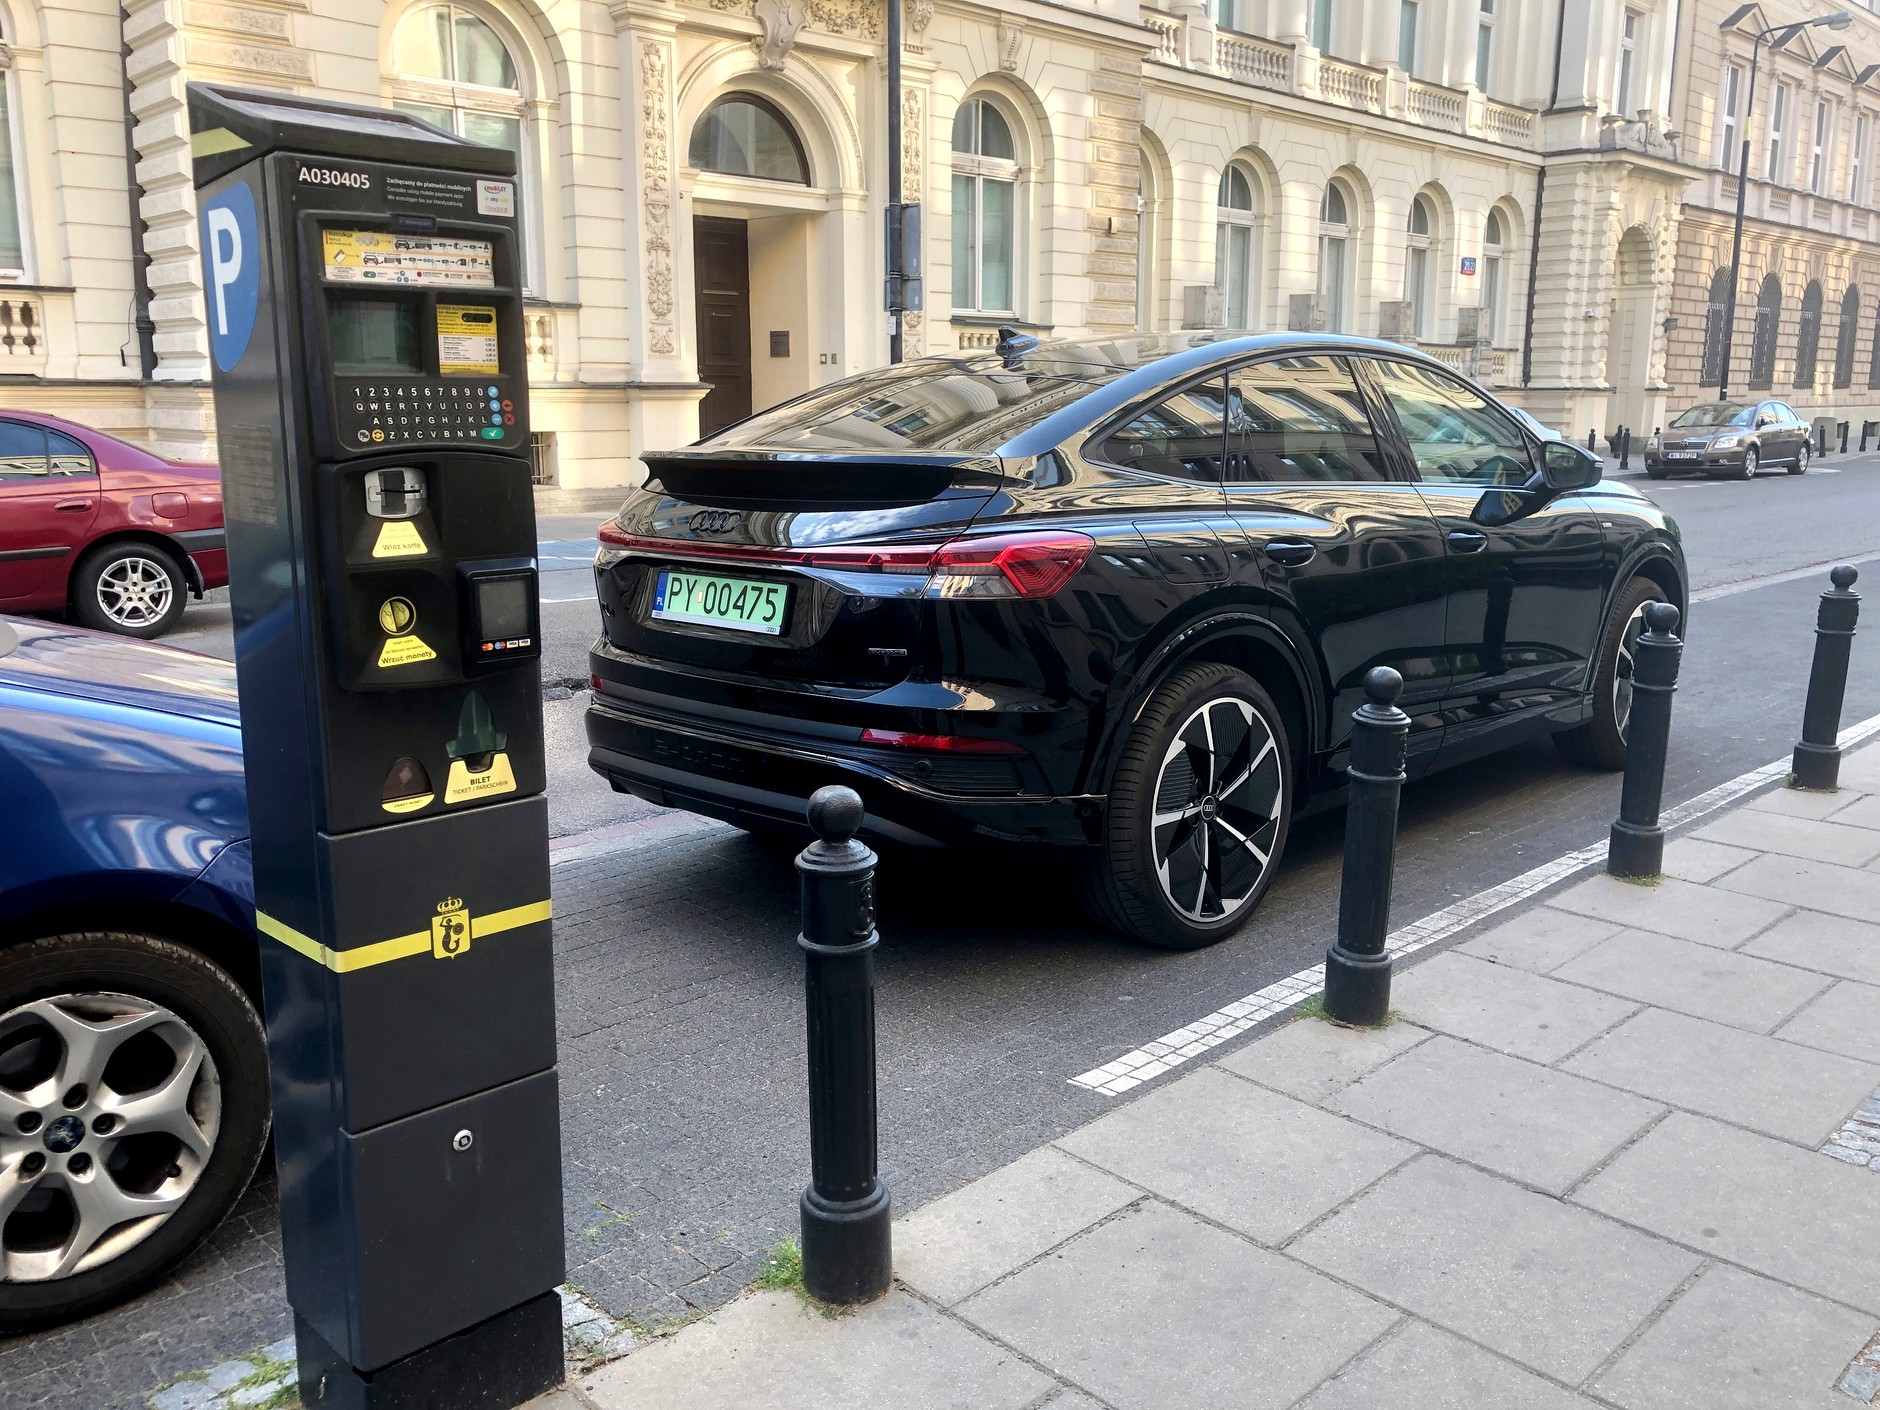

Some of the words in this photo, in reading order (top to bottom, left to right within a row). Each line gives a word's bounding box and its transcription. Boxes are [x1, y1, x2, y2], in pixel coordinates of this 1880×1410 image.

[299, 167, 370, 189] A030405
[386, 177, 415, 187] Zachęcamy
[447, 184, 472, 192] mobilnych
[208, 207, 242, 335] P
[354, 388, 360, 396] 1
[369, 388, 375, 396] 2
[383, 388, 389, 396] 3
[397, 388, 403, 396] 4
[411, 388, 417, 396] 5
[425, 388, 431, 396] 6
[438, 388, 444, 396] 7
[451, 388, 457, 396] 8
[464, 388, 470, 396] 9
[478, 388, 483, 396] 0
[656, 596, 663, 606] PL
[668, 576, 698, 612] PY
[704, 581, 779, 622] 00475
[381, 656, 404, 664] Wrzuć
[406, 651, 432, 660] monety
[470, 776, 491, 785] BILET
[476, 780, 509, 790] PARKSCHEIN
